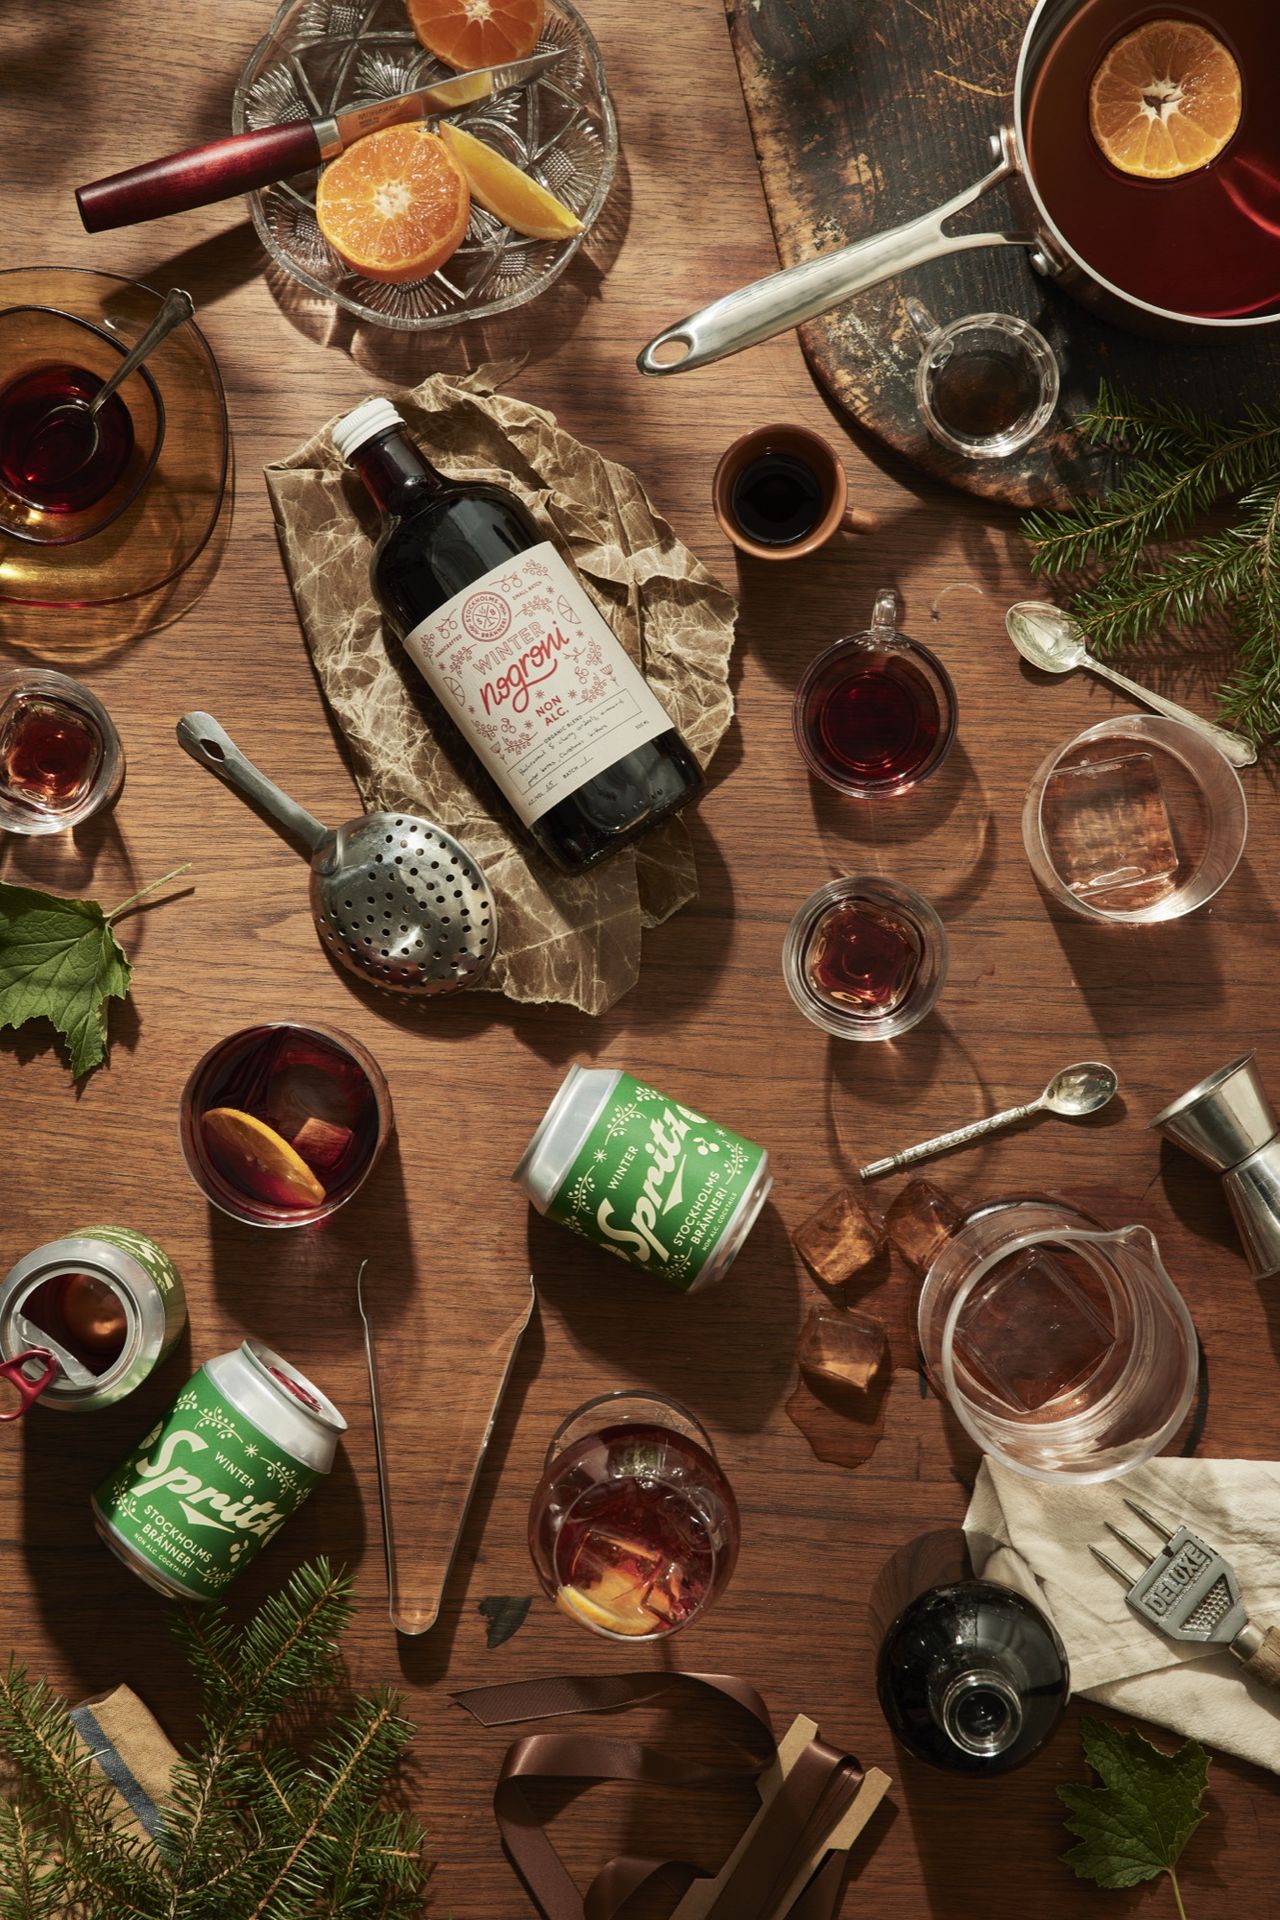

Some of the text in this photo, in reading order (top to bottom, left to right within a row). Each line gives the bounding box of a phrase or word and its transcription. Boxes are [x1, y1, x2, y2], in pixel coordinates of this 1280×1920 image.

[466, 596, 498, 622] STOCKHOLMS
[472, 622, 545, 675] WINTER
[480, 620, 570, 716] nogroni
[536, 696, 561, 717] NON
[544, 707, 569, 726] ALC.
[544, 726, 566, 744] ORGANIC
[566, 715, 583, 728] BLEND
[563, 766, 578, 779] BATCH
[597, 1106, 692, 1263] Spritz
[608, 1145, 639, 1190] WINTER
[672, 1171, 720, 1247] STOCKHOLMS
[690, 1187, 728, 1245] BRÄNNERI
[702, 1192, 738, 1251] NON ALC. COCKTAILS
[215, 1451, 256, 1489] WINTER
[134, 1532, 147, 1545] NON
[158, 1553, 187, 1578] COCKTAILS
[142, 1523, 195, 1569] BRÄNNERI
[144, 1504, 213, 1563] STOCKHOLMS
[1144, 1545, 1207, 1616] DELUXE
